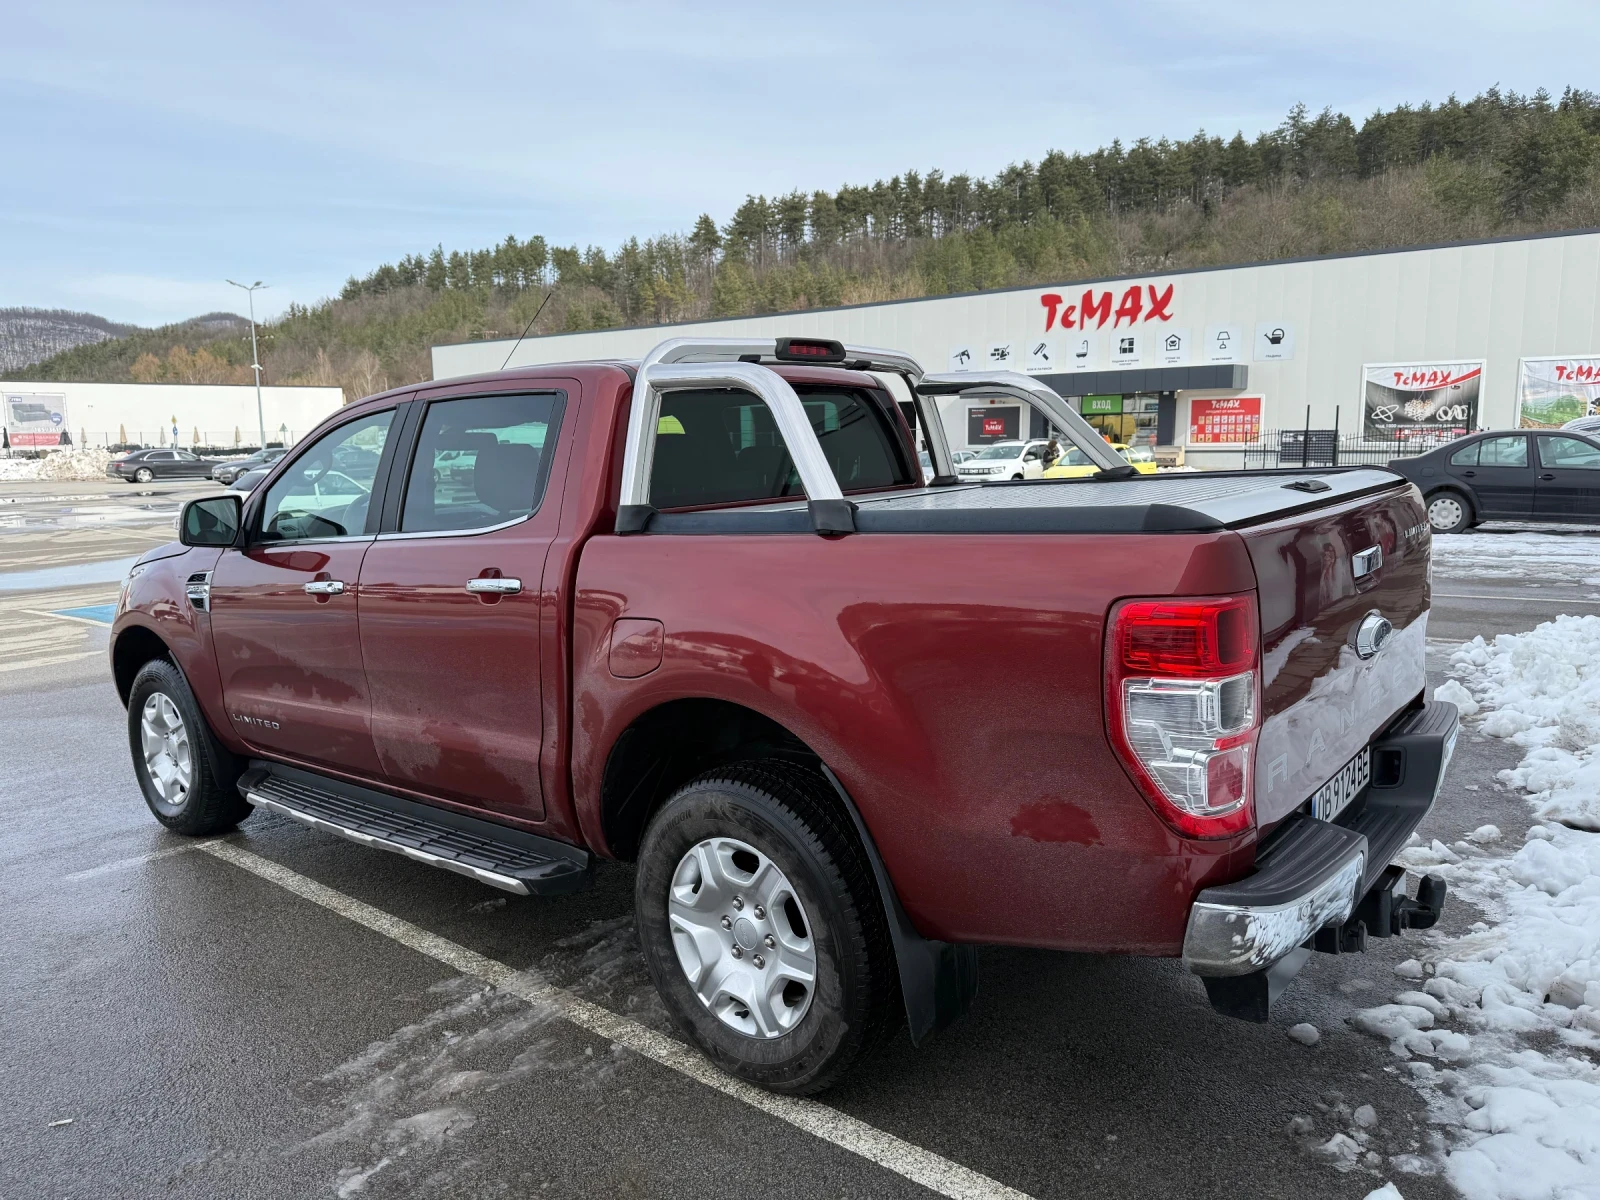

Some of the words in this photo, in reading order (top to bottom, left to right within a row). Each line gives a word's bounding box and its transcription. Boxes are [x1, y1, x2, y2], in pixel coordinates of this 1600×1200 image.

[1041, 283, 1174, 332] TeMAX
[1092, 400, 1111, 410] ВХОД
[232, 713, 280, 730] LIMITED
[1267, 657, 1420, 793] RANGE
